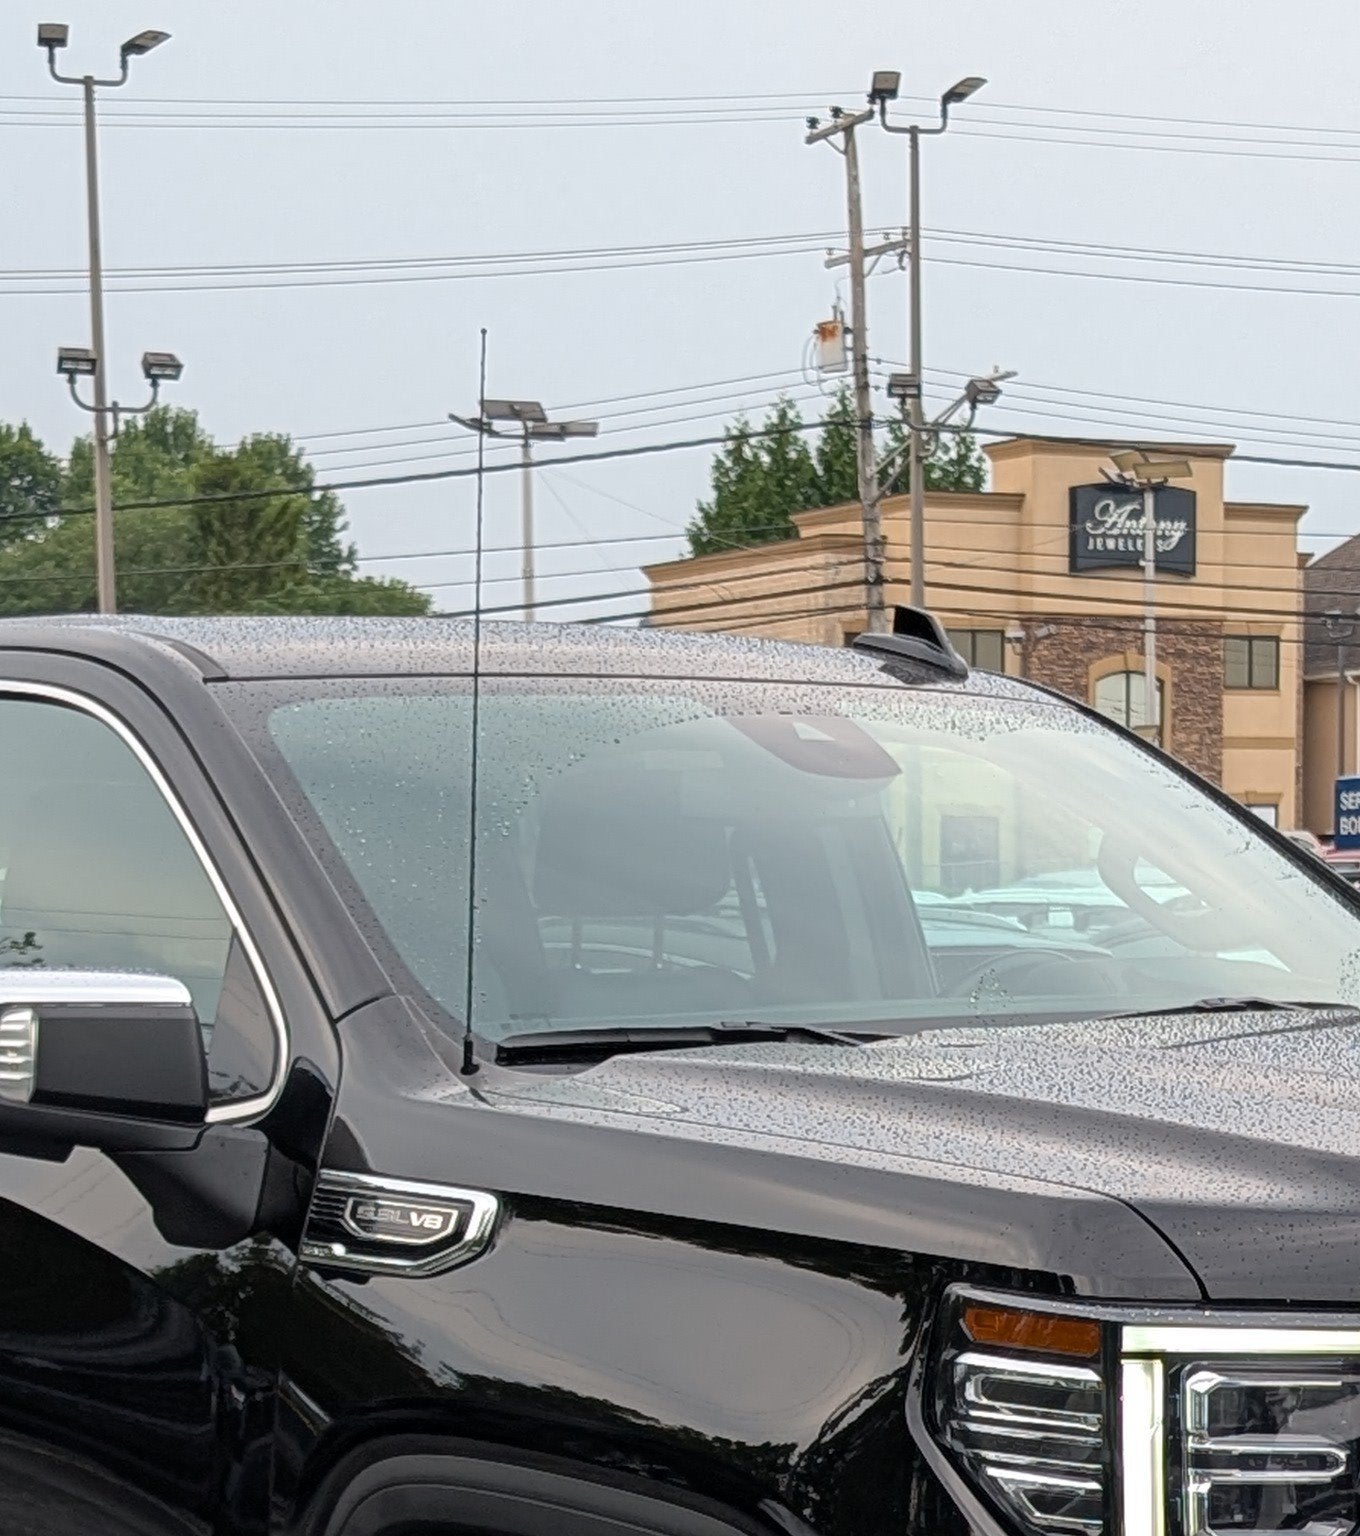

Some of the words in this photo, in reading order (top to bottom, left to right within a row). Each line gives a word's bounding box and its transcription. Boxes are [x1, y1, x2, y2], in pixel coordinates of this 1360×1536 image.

[1086, 500, 1187, 550] Antny
[1087, 537, 1164, 551] JEWELES
[409, 1211, 444, 1230] V8
